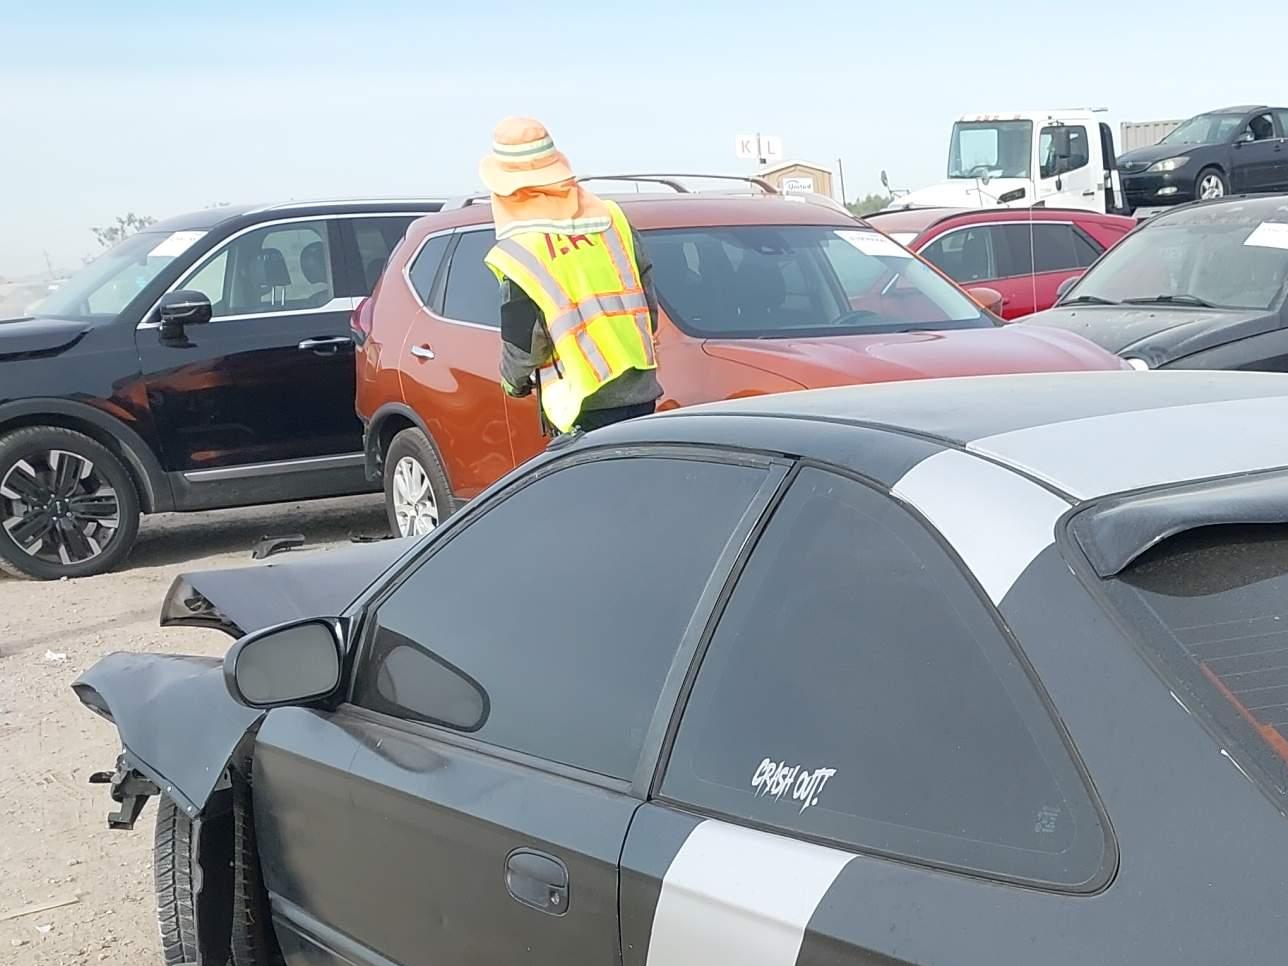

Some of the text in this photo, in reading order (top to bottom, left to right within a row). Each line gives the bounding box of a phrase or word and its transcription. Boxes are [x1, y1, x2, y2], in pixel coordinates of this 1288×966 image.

[741, 140, 752, 154] K
[767, 140, 777, 155] L
[751, 758, 801, 803] CRASH
